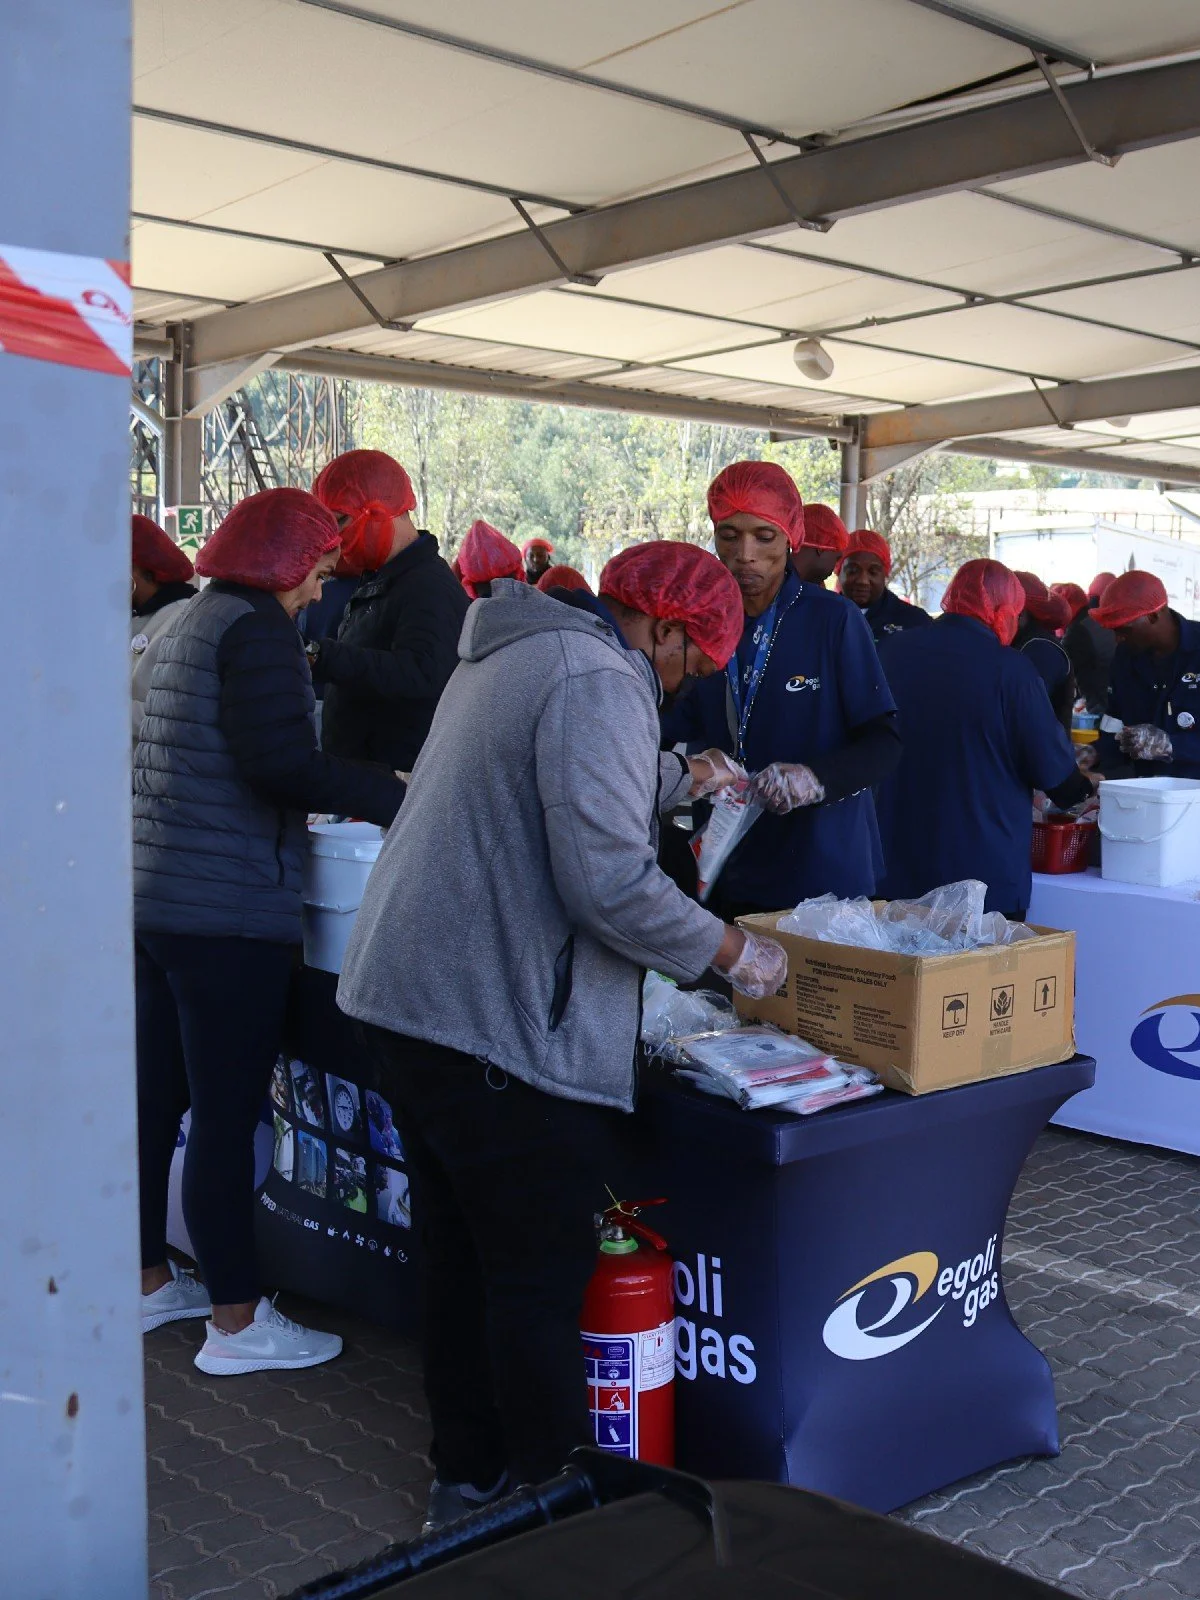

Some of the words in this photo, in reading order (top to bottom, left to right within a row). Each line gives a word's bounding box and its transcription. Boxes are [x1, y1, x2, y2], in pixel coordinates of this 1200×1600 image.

[943, 1029, 956, 1038] KEEP
[303, 1218, 320, 1231] GAS
[674, 1252, 723, 1317] oli
[938, 1233, 998, 1300] egoli
[962, 1271, 998, 1328] gas
[674, 1315, 757, 1384] gas
